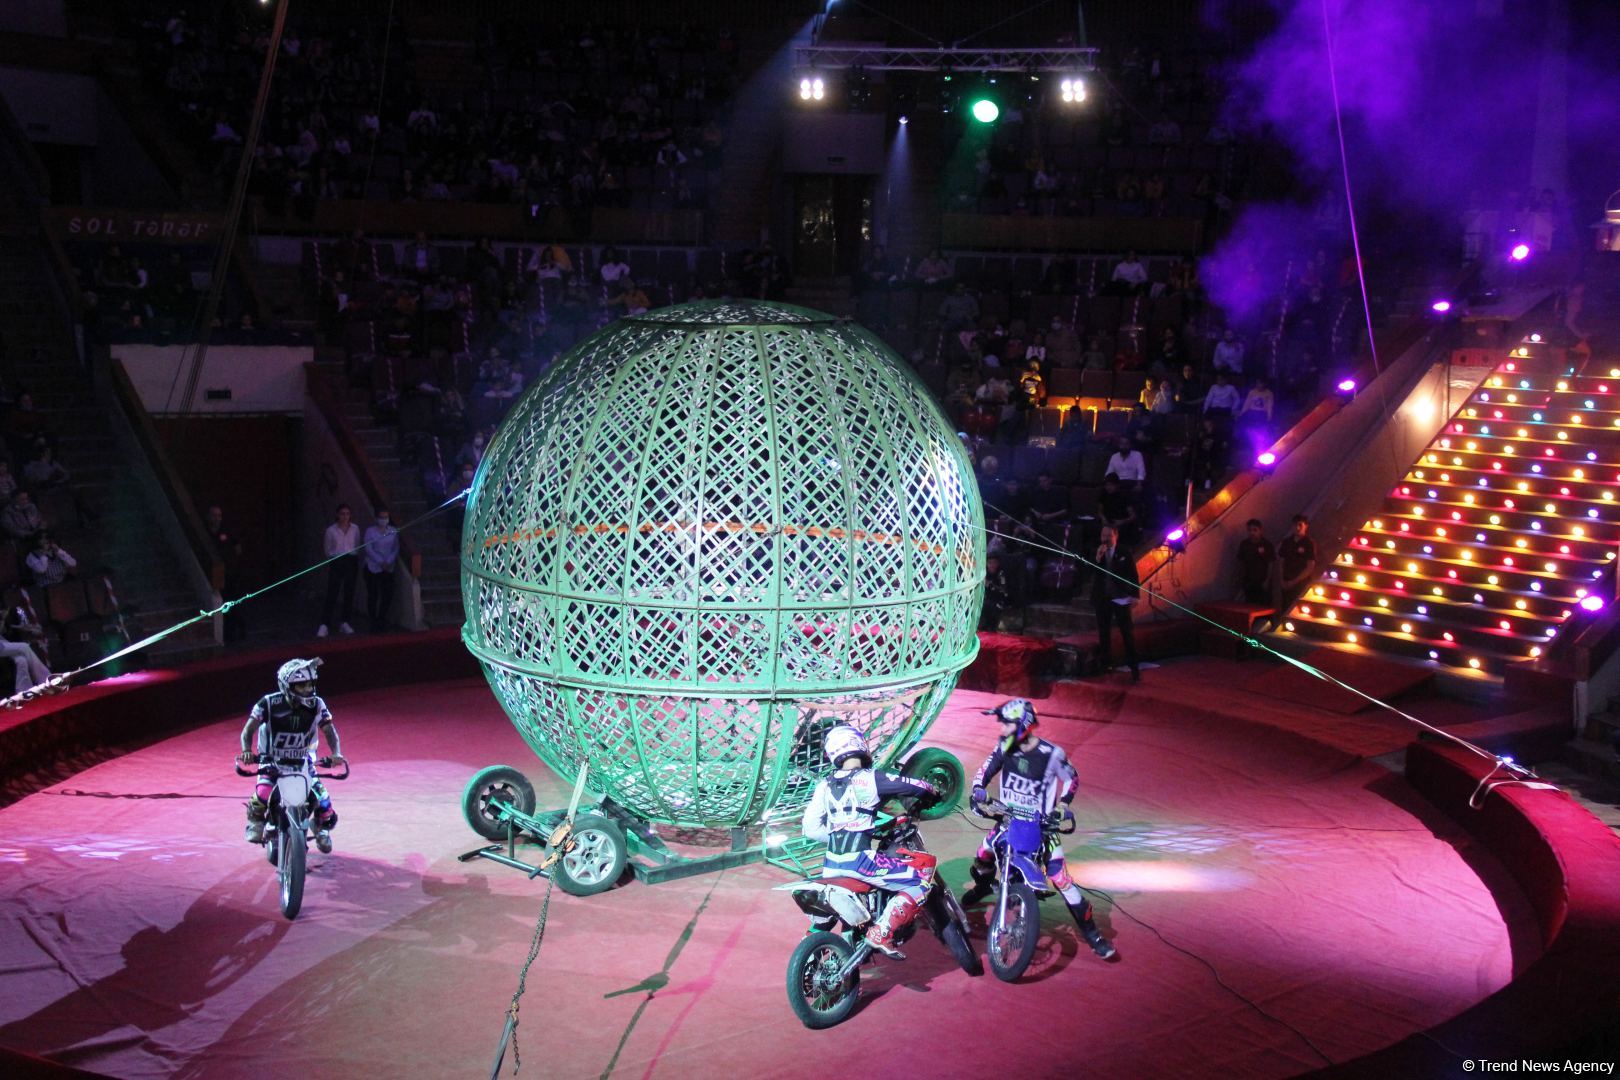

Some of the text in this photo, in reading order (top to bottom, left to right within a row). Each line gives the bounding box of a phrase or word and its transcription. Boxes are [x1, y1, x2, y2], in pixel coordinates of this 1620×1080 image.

[68, 217, 117, 235] SOL
[273, 732, 309, 748] FOX
[1004, 771, 1041, 796] FOX
